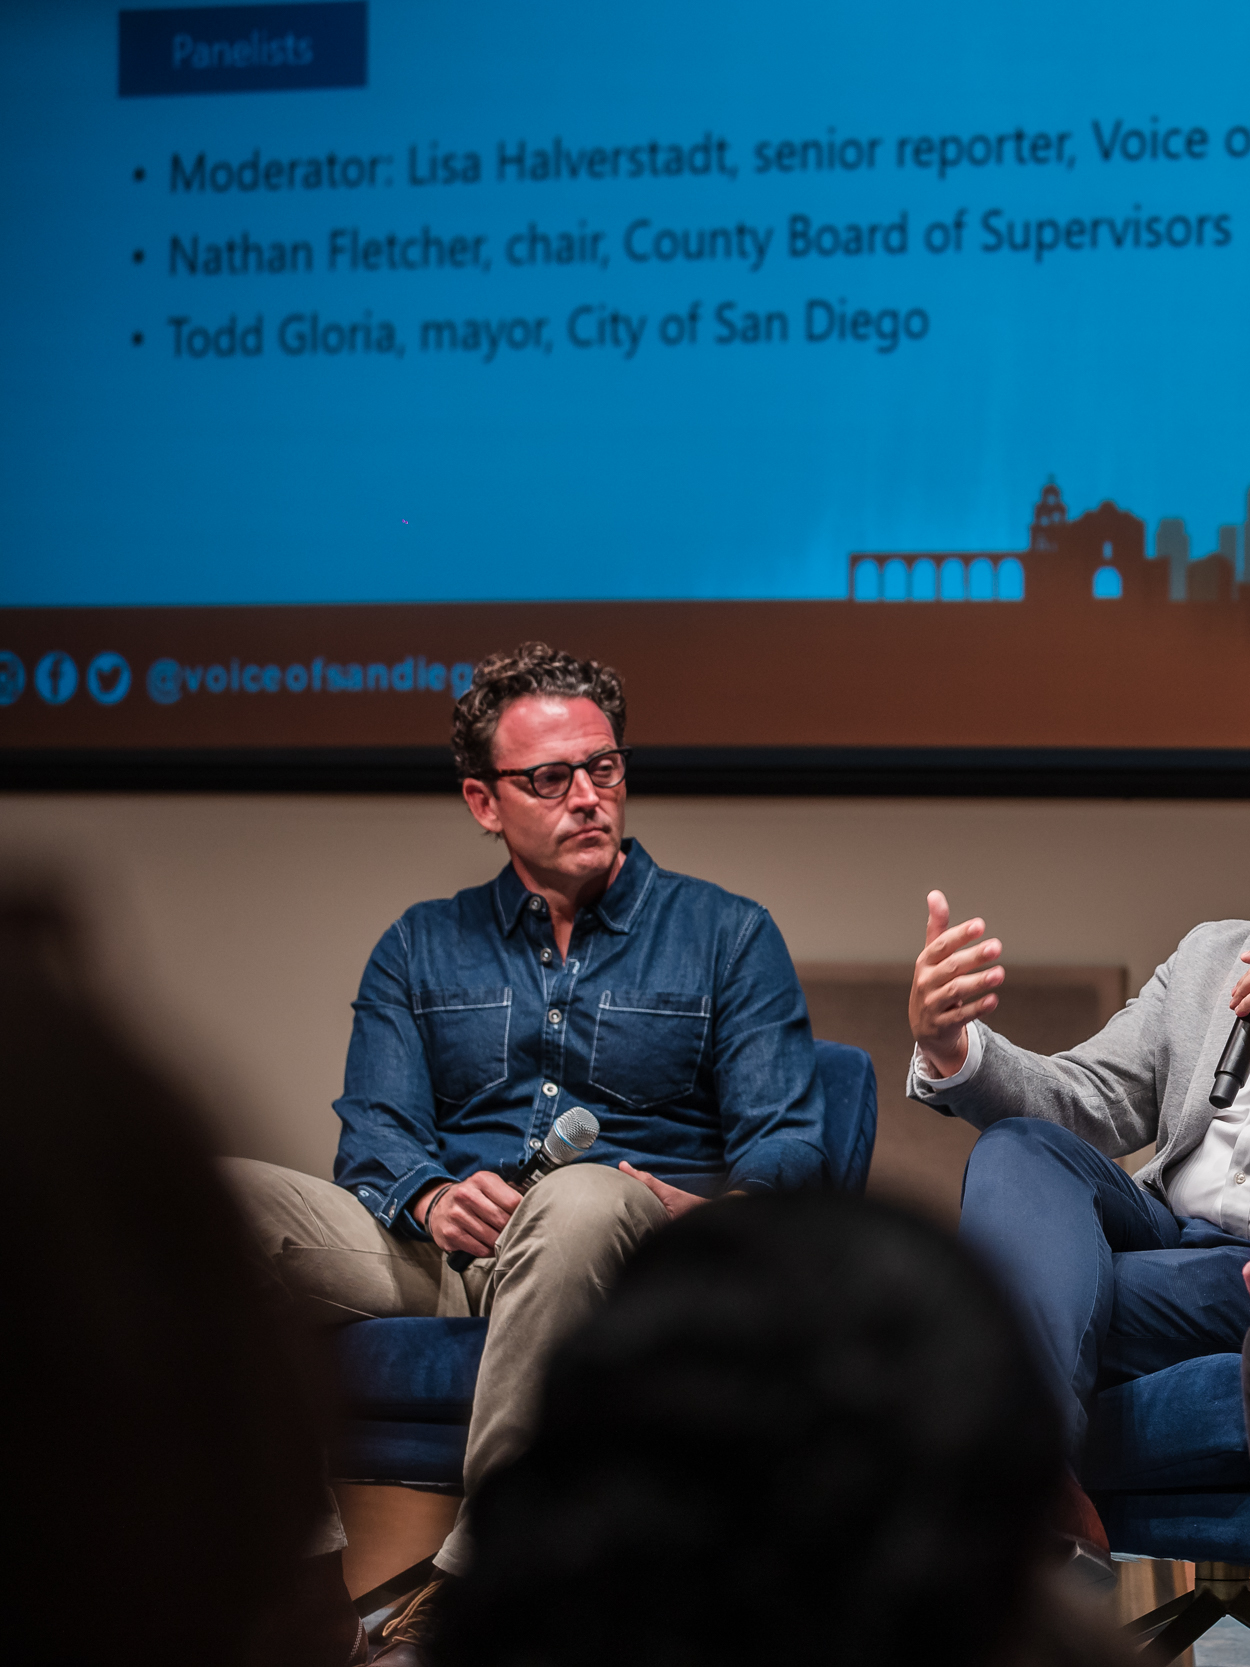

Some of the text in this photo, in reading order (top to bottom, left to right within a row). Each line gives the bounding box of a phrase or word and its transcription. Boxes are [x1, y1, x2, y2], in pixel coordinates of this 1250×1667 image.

[172, 31, 313, 68] Panelists
[169, 150, 393, 193] Moderator:
[409, 144, 481, 186] Lisa
[497, 130, 738, 182] Halverstadt,
[754, 127, 882, 174] senior
[896, 126, 1075, 178] reporter,
[1092, 116, 1209, 162] Voice
[168, 204, 1231, 276] Nathan Fletcher, chair, County Board of Supervisors
[168, 299, 930, 363] Todd Gloria, mayor, City of San Diego
[147, 655, 474, 705] @voiceofsandieg
